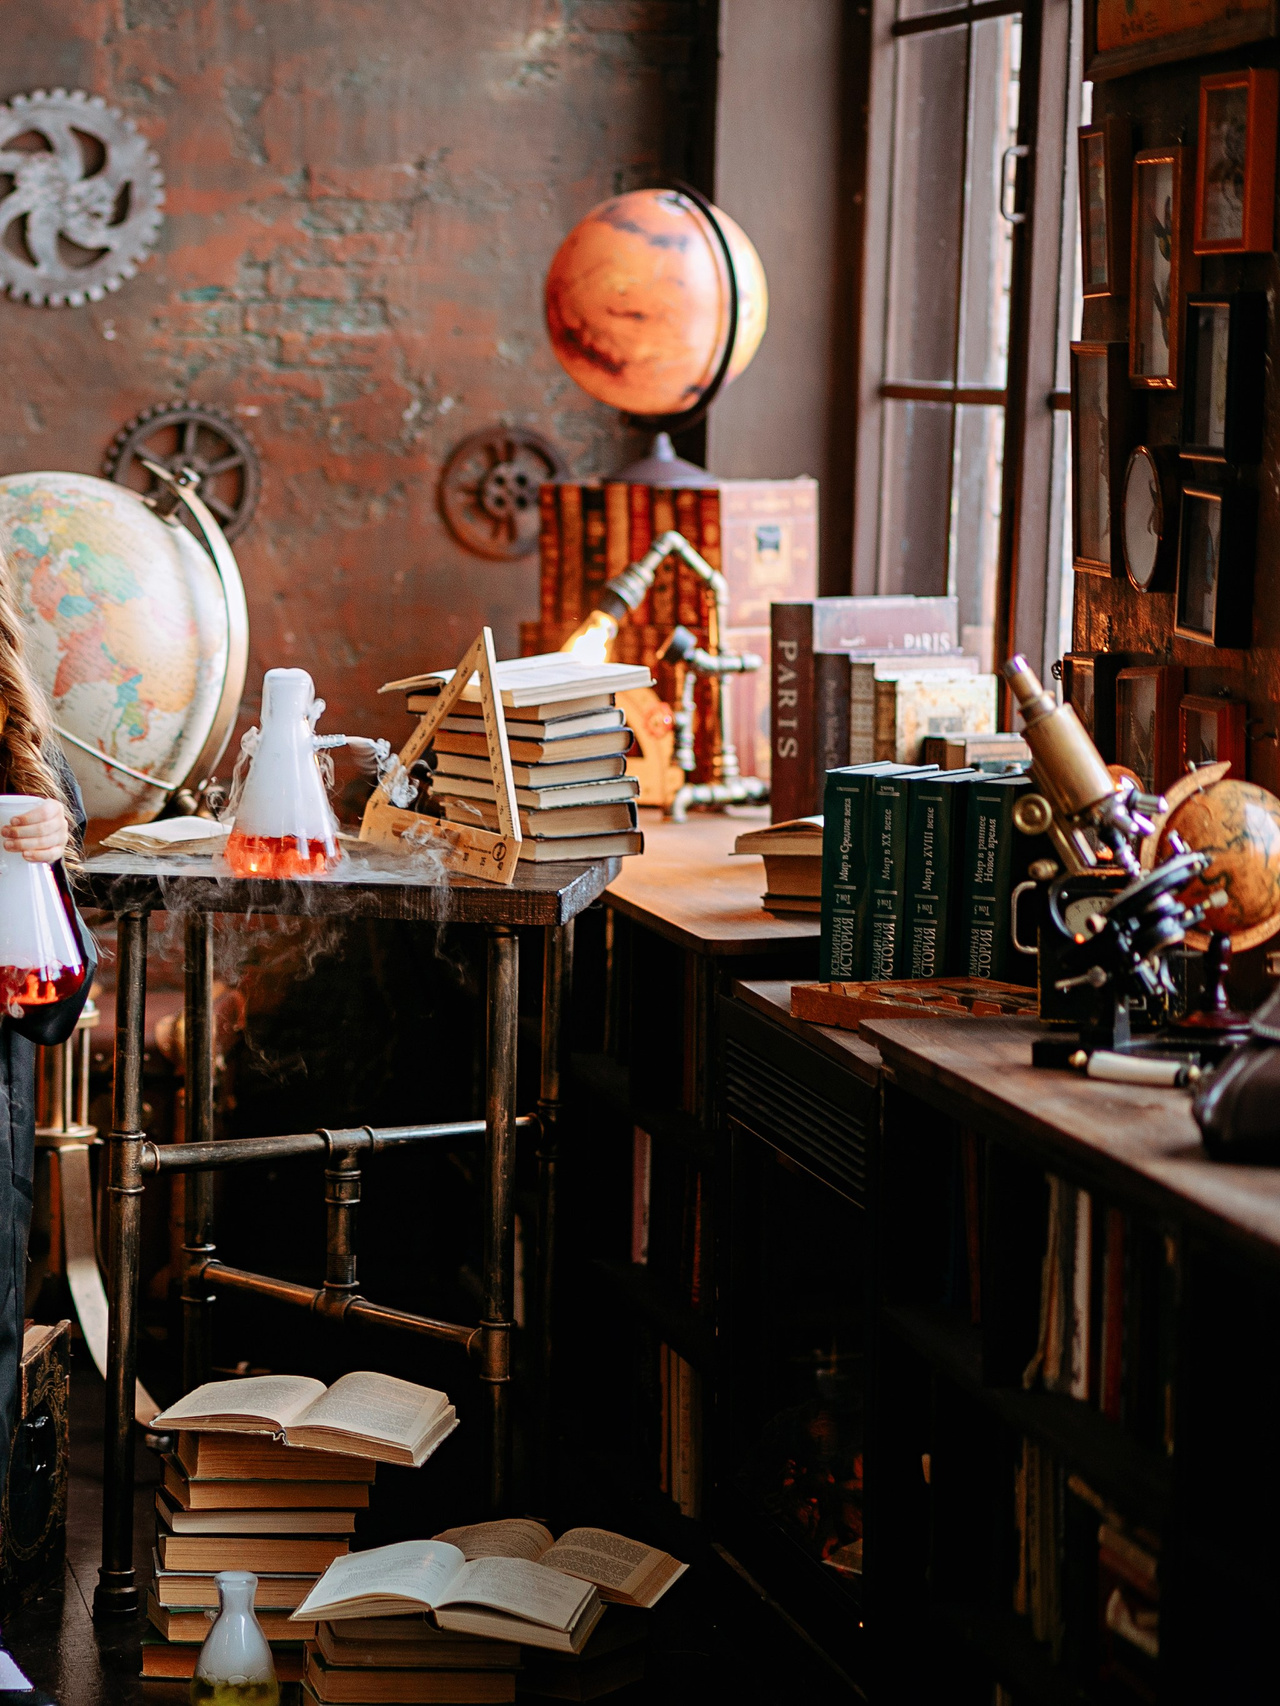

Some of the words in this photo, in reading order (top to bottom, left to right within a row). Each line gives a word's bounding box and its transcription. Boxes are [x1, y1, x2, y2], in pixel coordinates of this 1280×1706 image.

[777, 639, 799, 759] PARIS
[882, 833, 891, 847] XX
[923, 831, 933, 858] XVIII
[988, 818, 998, 849] время
[838, 861, 851, 882] Мир
[882, 858, 894, 880] Мир
[922, 868, 935, 891] Мир
[975, 861, 987, 884] Мир
[831, 917, 842, 976] ВСЕМИРНАЯ
[840, 917, 854, 977] ИСТОРИЯ
[911, 927, 923, 979] СЕМИРНАЯ
[921, 927, 936, 978] СТОРИЯ
[969, 928, 980, 977] ЕМИРНАЯ
[978, 928, 993, 979] СТОРИЯ
